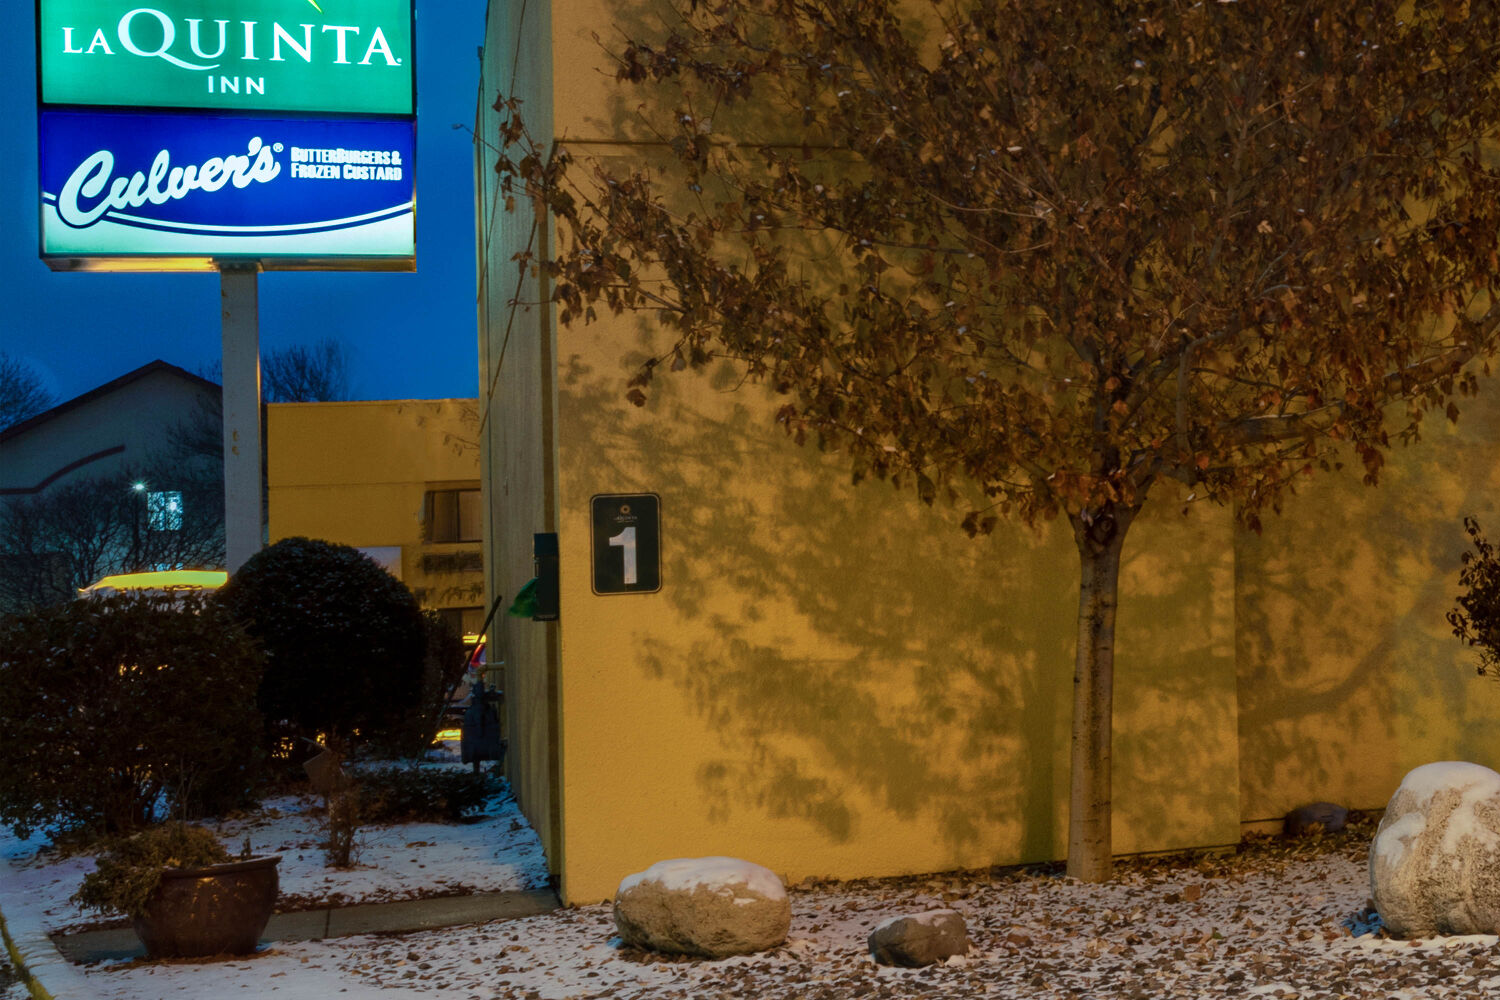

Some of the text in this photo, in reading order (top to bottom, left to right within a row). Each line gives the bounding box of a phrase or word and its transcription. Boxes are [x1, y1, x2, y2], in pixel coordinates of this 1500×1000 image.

[62, 7, 402, 71] LA QUINTA
[207, 75, 265, 95] INN
[391, 150, 402, 166] &
[290, 162, 403, 181] FROZEN CUSTARD
[609, 526, 637, 584] 1
